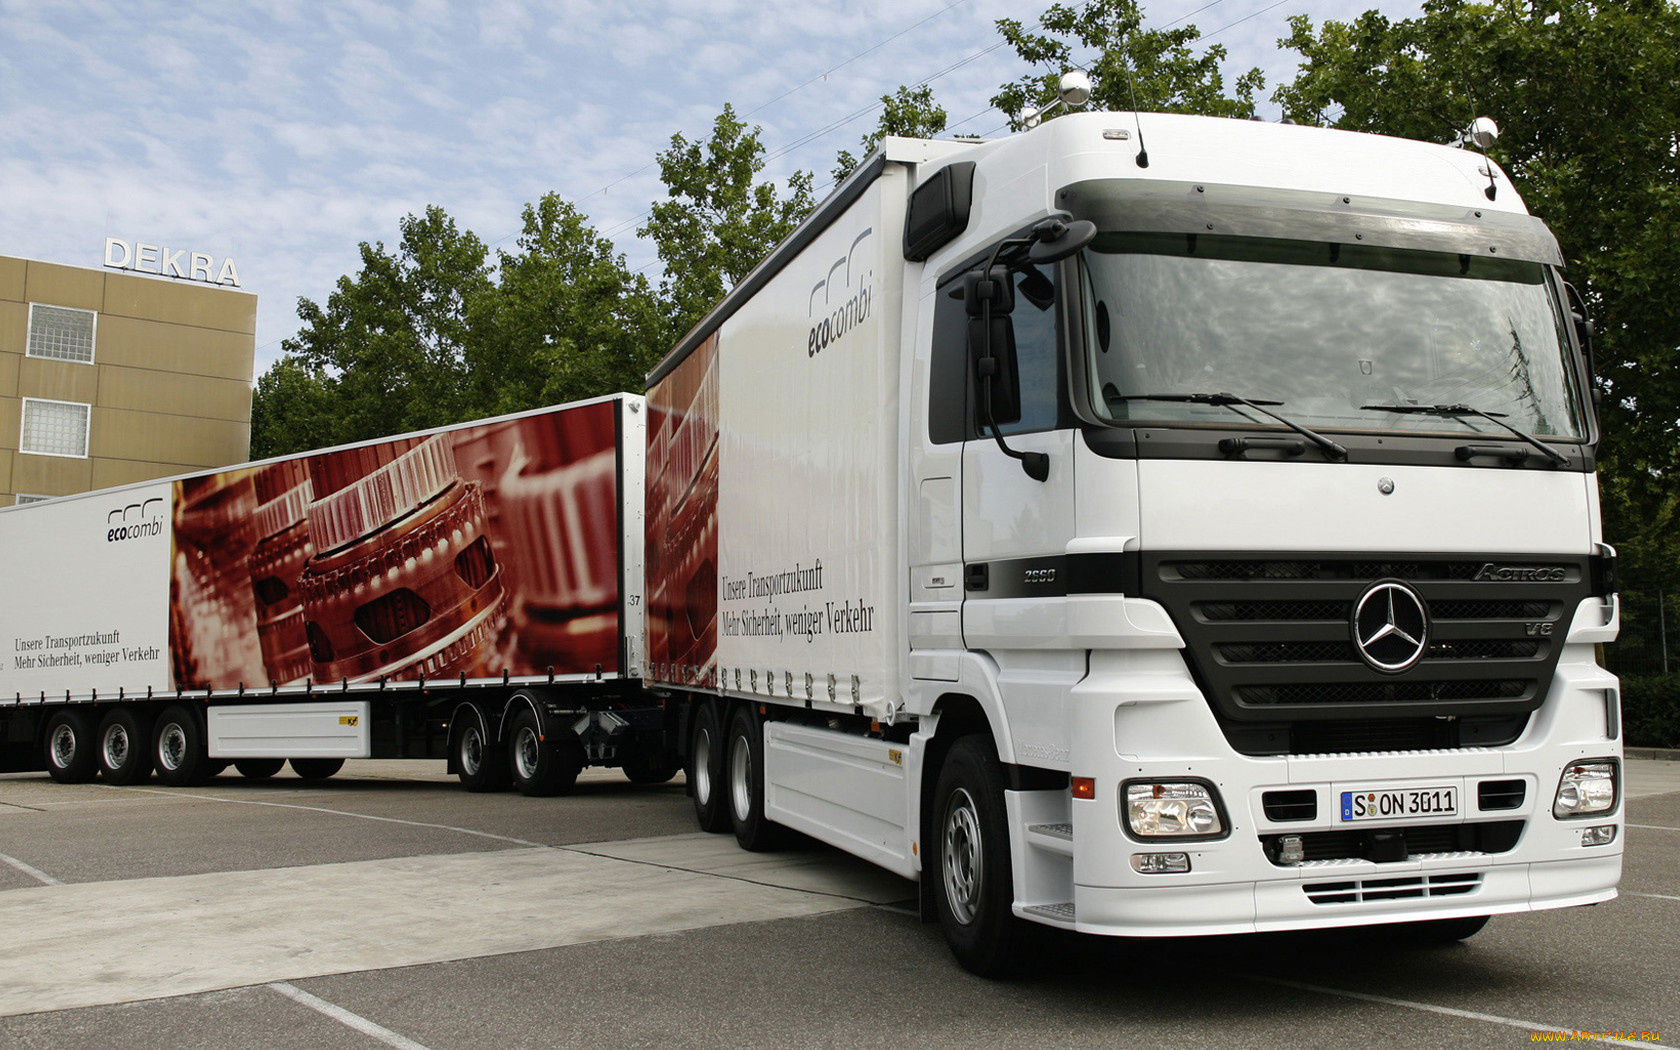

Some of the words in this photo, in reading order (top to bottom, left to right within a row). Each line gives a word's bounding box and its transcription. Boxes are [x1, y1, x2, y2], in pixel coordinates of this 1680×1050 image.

[103, 237, 241, 288] DEKRA
[807, 269, 873, 358] ecocombi
[107, 515, 163, 542] ecocombi
[722, 576, 746, 601] Unsere
[748, 558, 823, 603] Transportzukunft
[722, 611, 740, 636] Mehr
[741, 607, 783, 643] Sicherheit,
[785, 604, 823, 643] weniger
[826, 598, 874, 634] Verkehr
[1525, 623, 1553, 635] V8
[15, 638, 43, 652] Unsere
[45, 629, 120, 650] Transportzukunft
[14, 656, 36, 670] Mehr
[37, 651, 83, 668] Sicherheit,
[84, 649, 120, 667] weniger
[122, 646, 160, 661] Verkehr
[1354, 795, 1366, 816] S
[1380, 793, 1404, 815] ON
[1409, 790, 1455, 813] 3011
